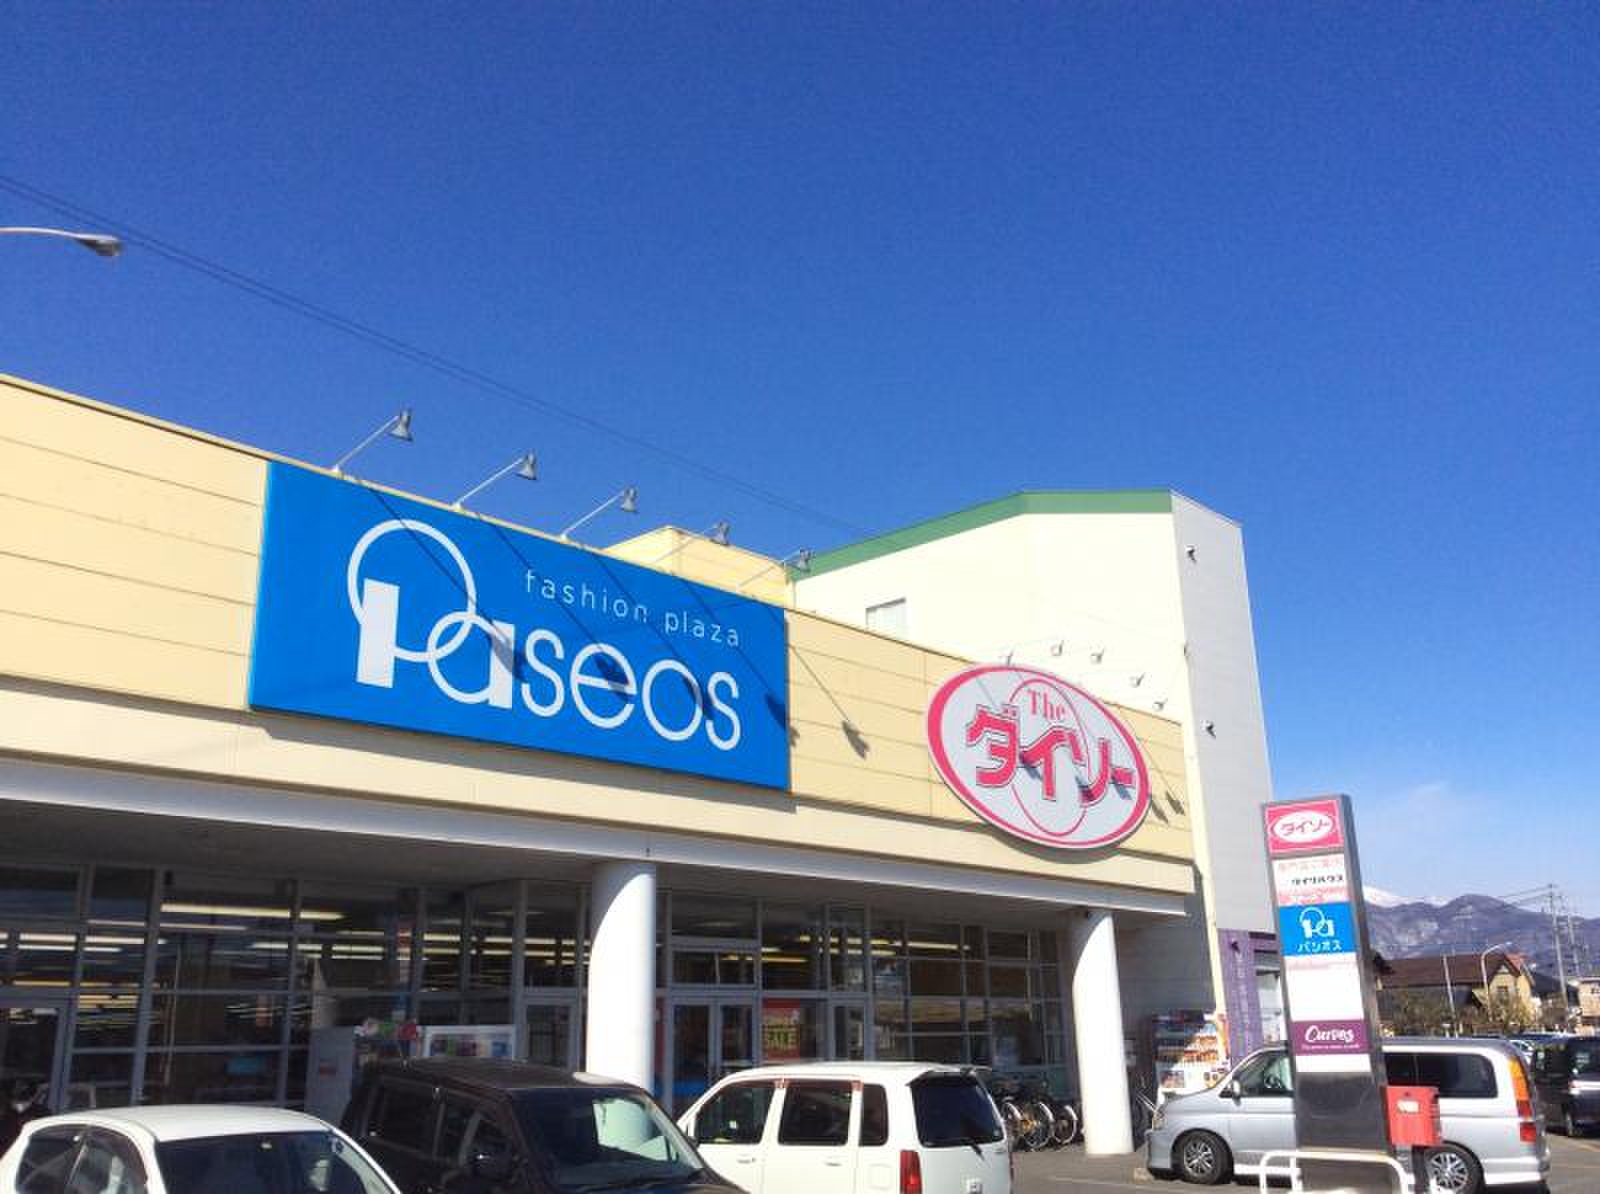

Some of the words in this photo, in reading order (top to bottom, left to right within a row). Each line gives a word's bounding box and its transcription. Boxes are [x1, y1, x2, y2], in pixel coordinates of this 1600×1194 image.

[346, 519, 741, 751] Paseos
[524, 570, 650, 625] fashion
[664, 611, 741, 649] plaza
[1027, 688, 1066, 721] The
[966, 704, 1134, 806] ダイソー
